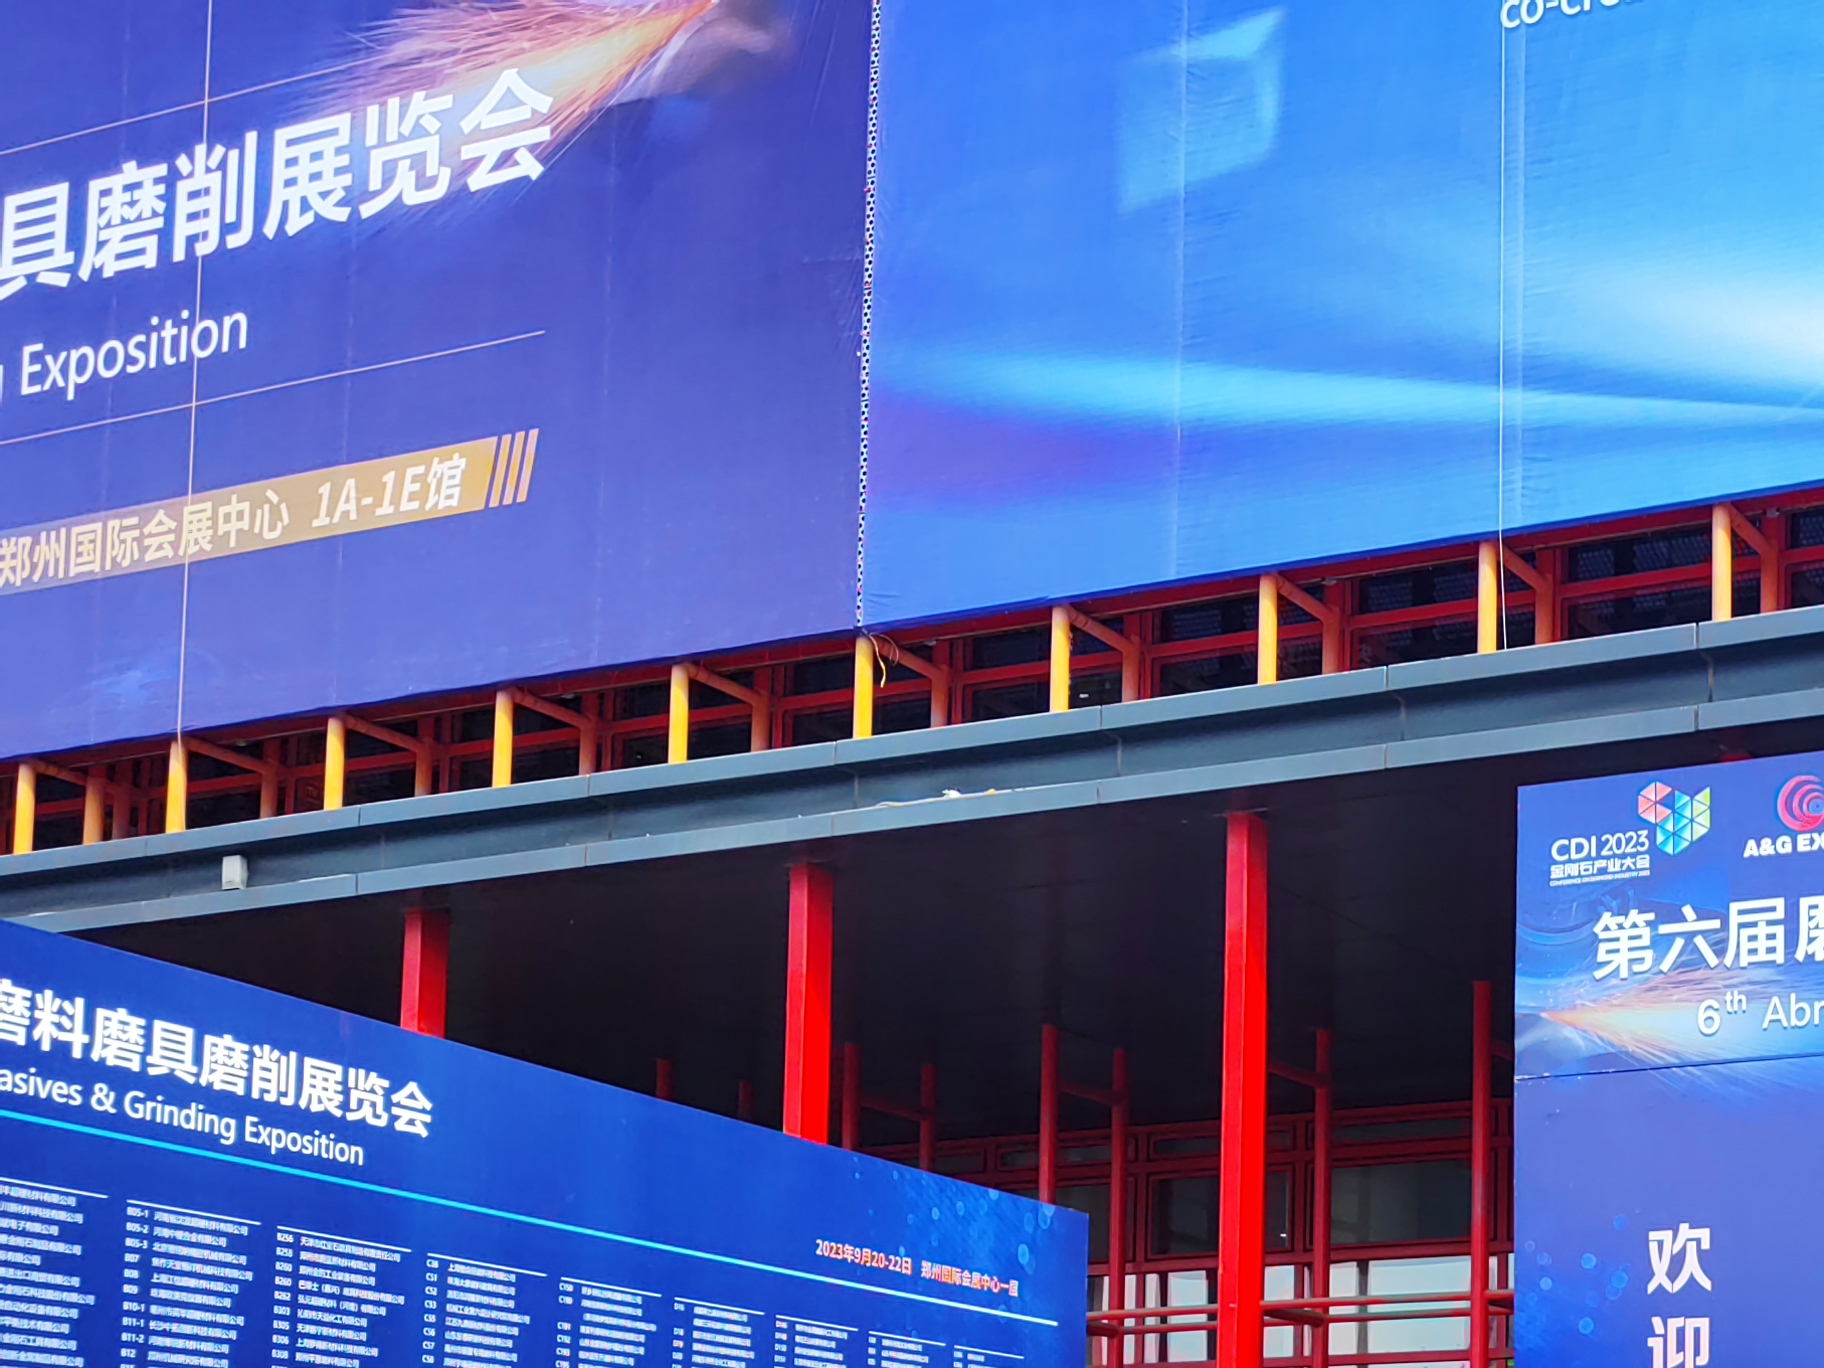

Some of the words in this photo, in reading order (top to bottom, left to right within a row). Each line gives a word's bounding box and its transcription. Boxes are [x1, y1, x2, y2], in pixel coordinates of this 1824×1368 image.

[21, 307, 249, 401] Exposition
[0, 489, 290, 588] 郑州国际会展中心
[312, 452, 466, 530] 1A-1E馆
[1551, 835, 1597, 861] CDI
[1600, 829, 1650, 856] 2023
[1743, 834, 1793, 858] A&G
[1550, 854, 1650, 879] 金刚石产业大会
[0, 978, 433, 1138] 磨料磨具磨削展览会
[90, 1082, 117, 1113] &
[124, 1090, 236, 1146] Grinding
[243, 1119, 365, 1166] Exposition
[815, 1239, 912, 1275] 2023年9月20-22日
[120, 1332, 144, 1344] B11-2
[122, 1316, 145, 1328] B11-1
[120, 1347, 137, 1359] B12
